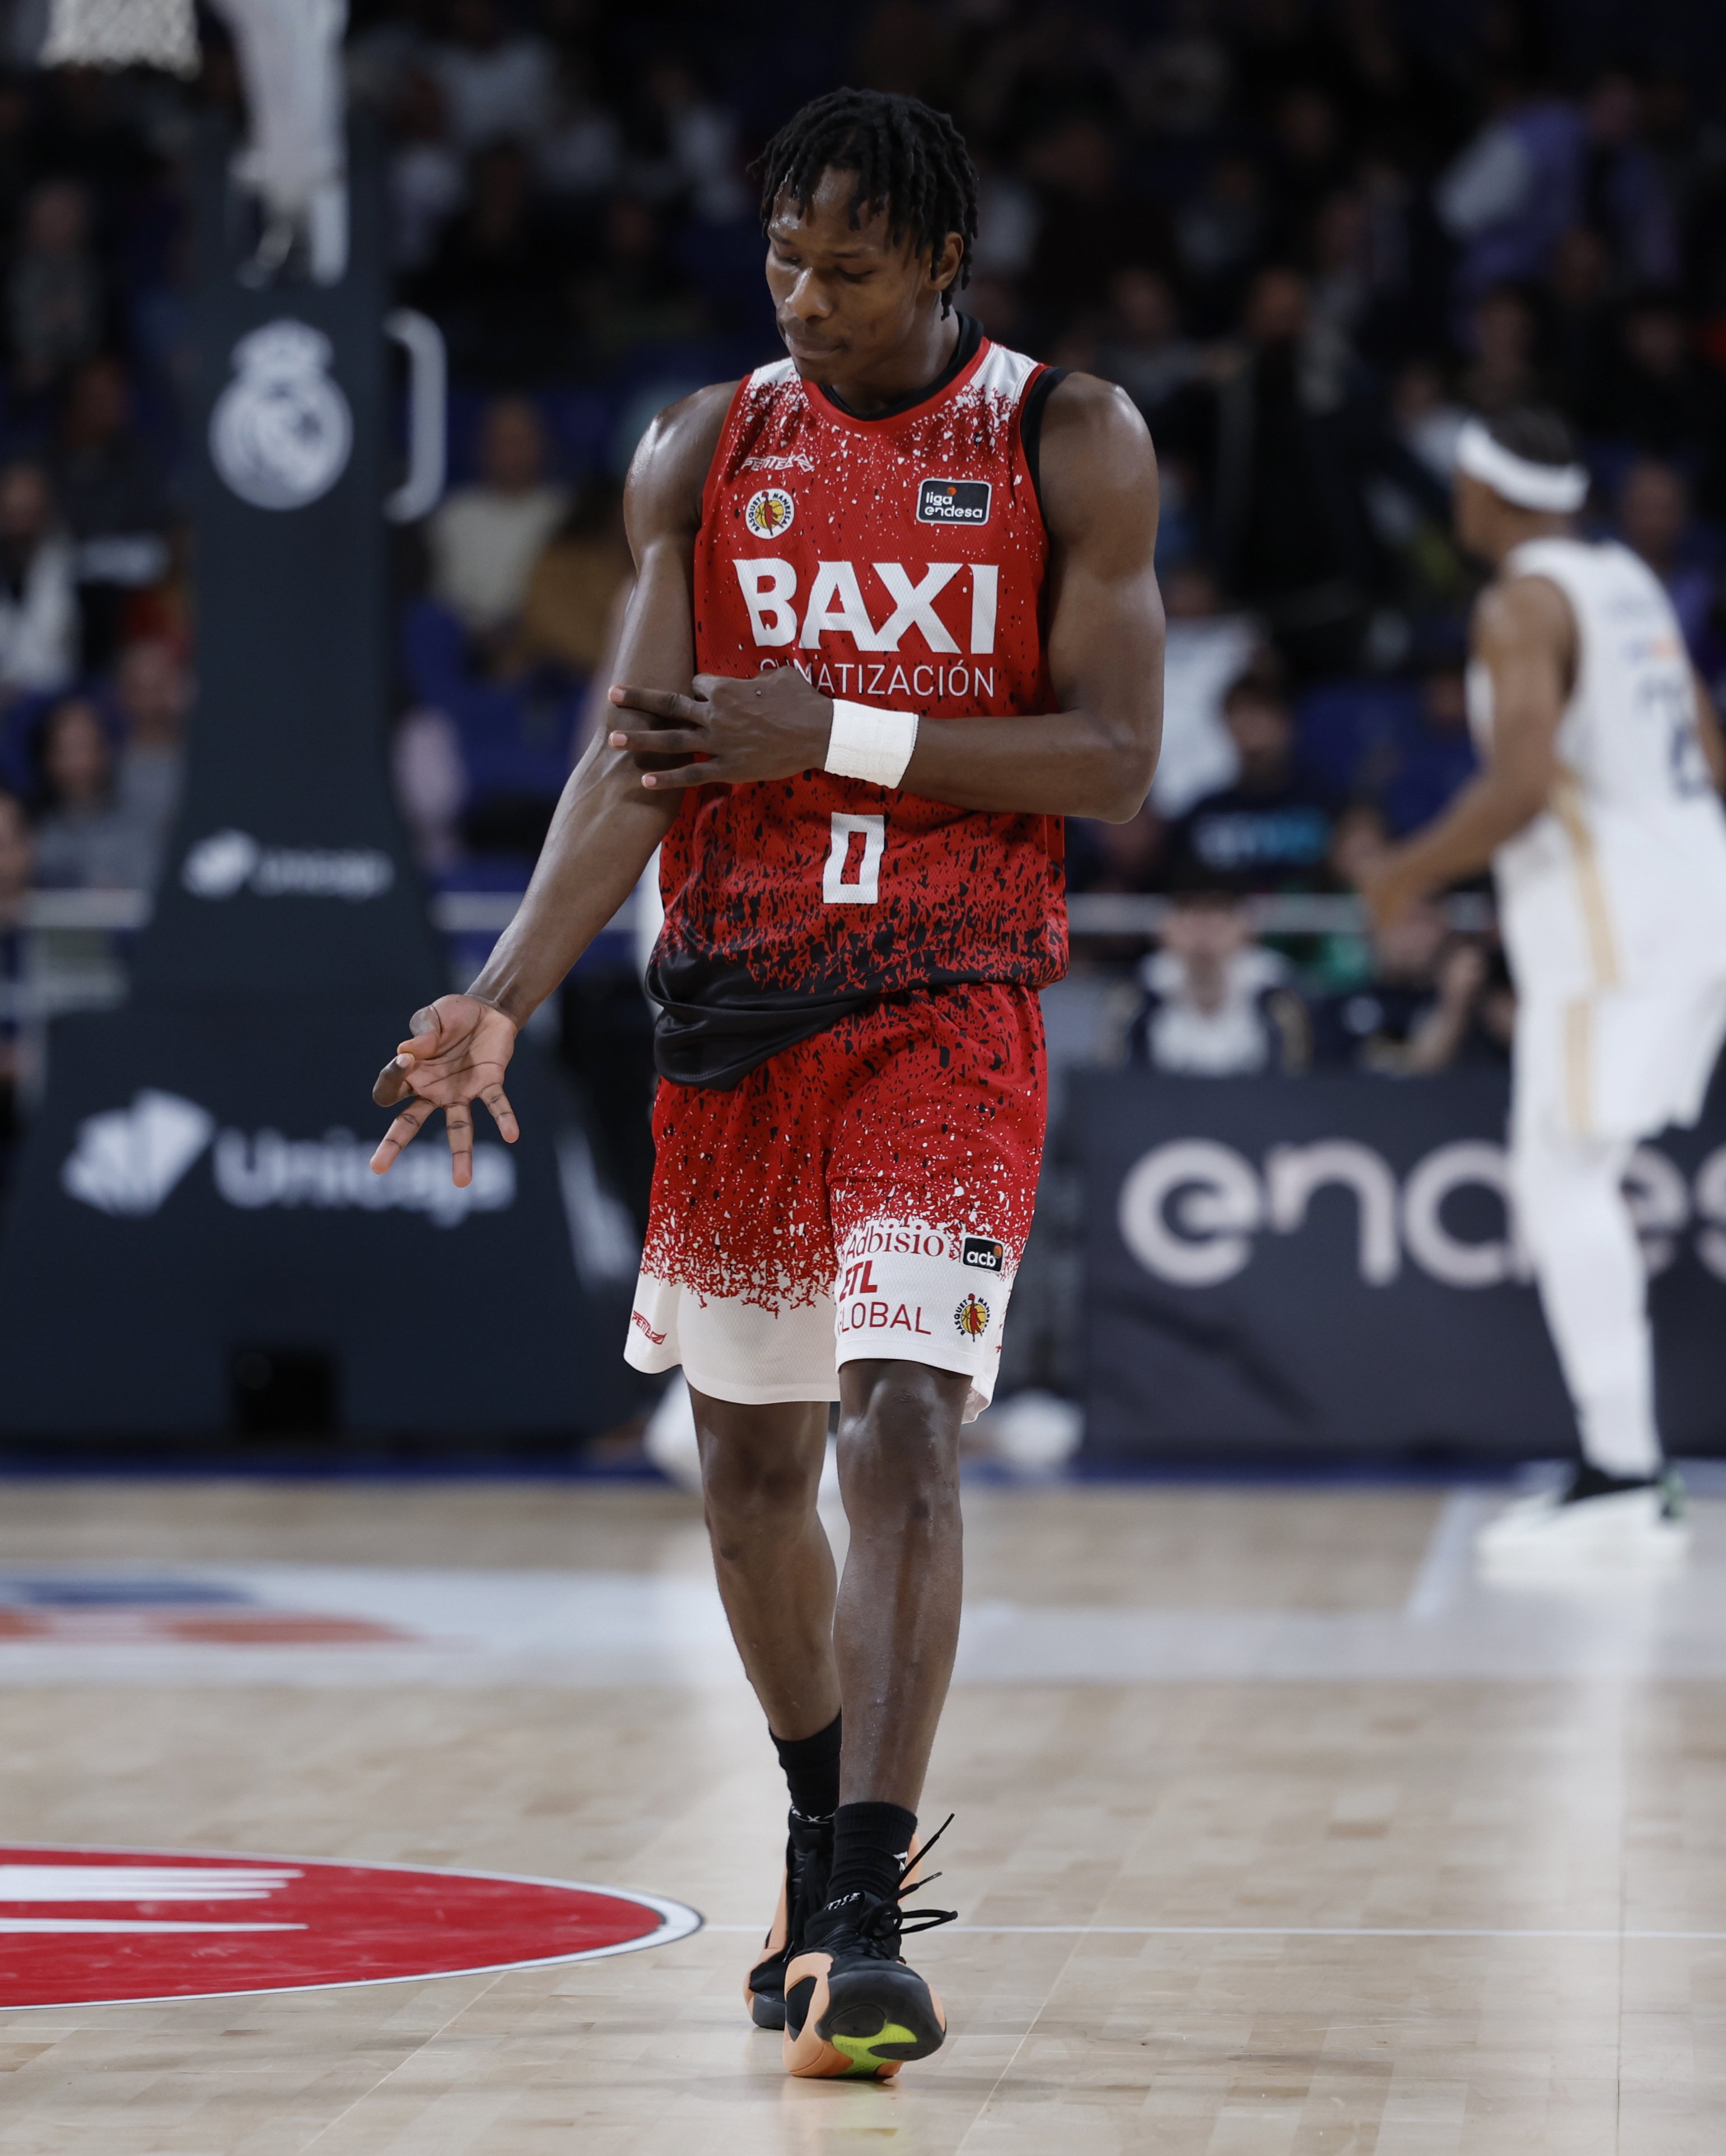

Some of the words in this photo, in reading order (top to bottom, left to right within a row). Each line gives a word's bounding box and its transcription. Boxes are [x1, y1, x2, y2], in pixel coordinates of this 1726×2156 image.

[772, 493, 791, 525] MANRESA
[924, 505, 983, 519] endesa
[925, 492, 953, 506] liga
[733, 558, 999, 654] BAXI
[760, 658, 994, 698] MATIZACIÓN
[823, 811, 885, 904] 0
[846, 1223, 944, 1263] Adbisio
[967, 1251, 997, 1267] acb
[839, 1260, 878, 1303] ETL
[837, 1301, 932, 1336] LOBAL
